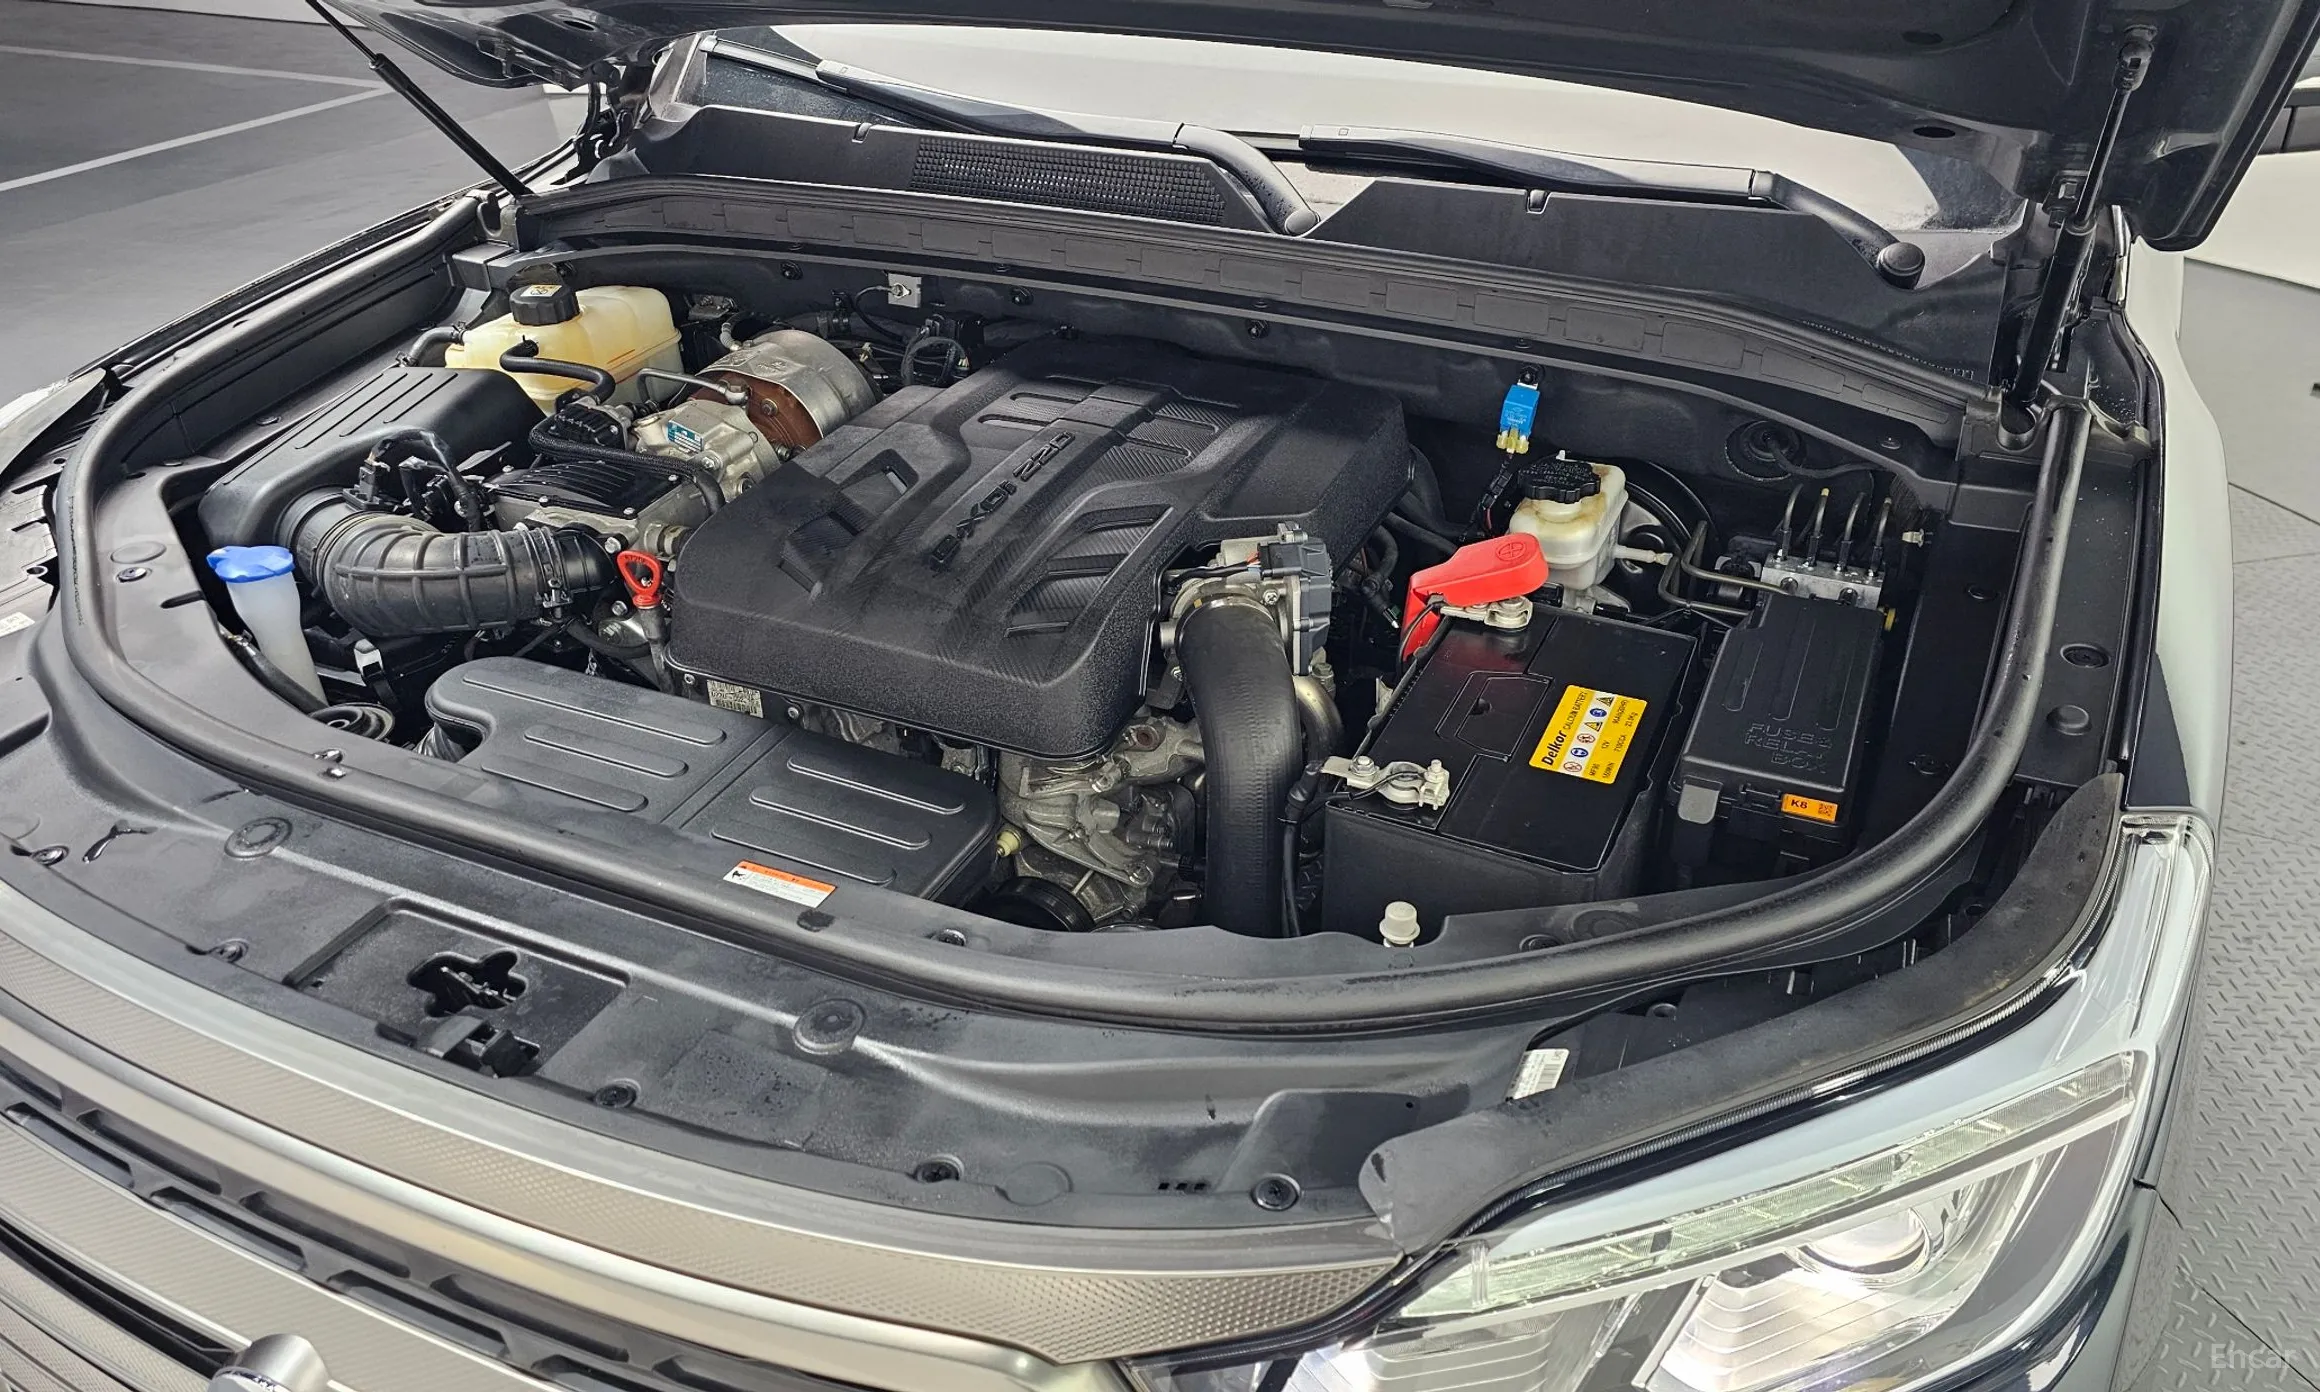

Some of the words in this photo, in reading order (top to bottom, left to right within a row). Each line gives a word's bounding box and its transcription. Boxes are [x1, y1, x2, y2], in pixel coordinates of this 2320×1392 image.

[1012, 431, 1076, 482] 220
[1541, 730, 1567, 765] Delkor
[1771, 752, 1827, 774] BOX
